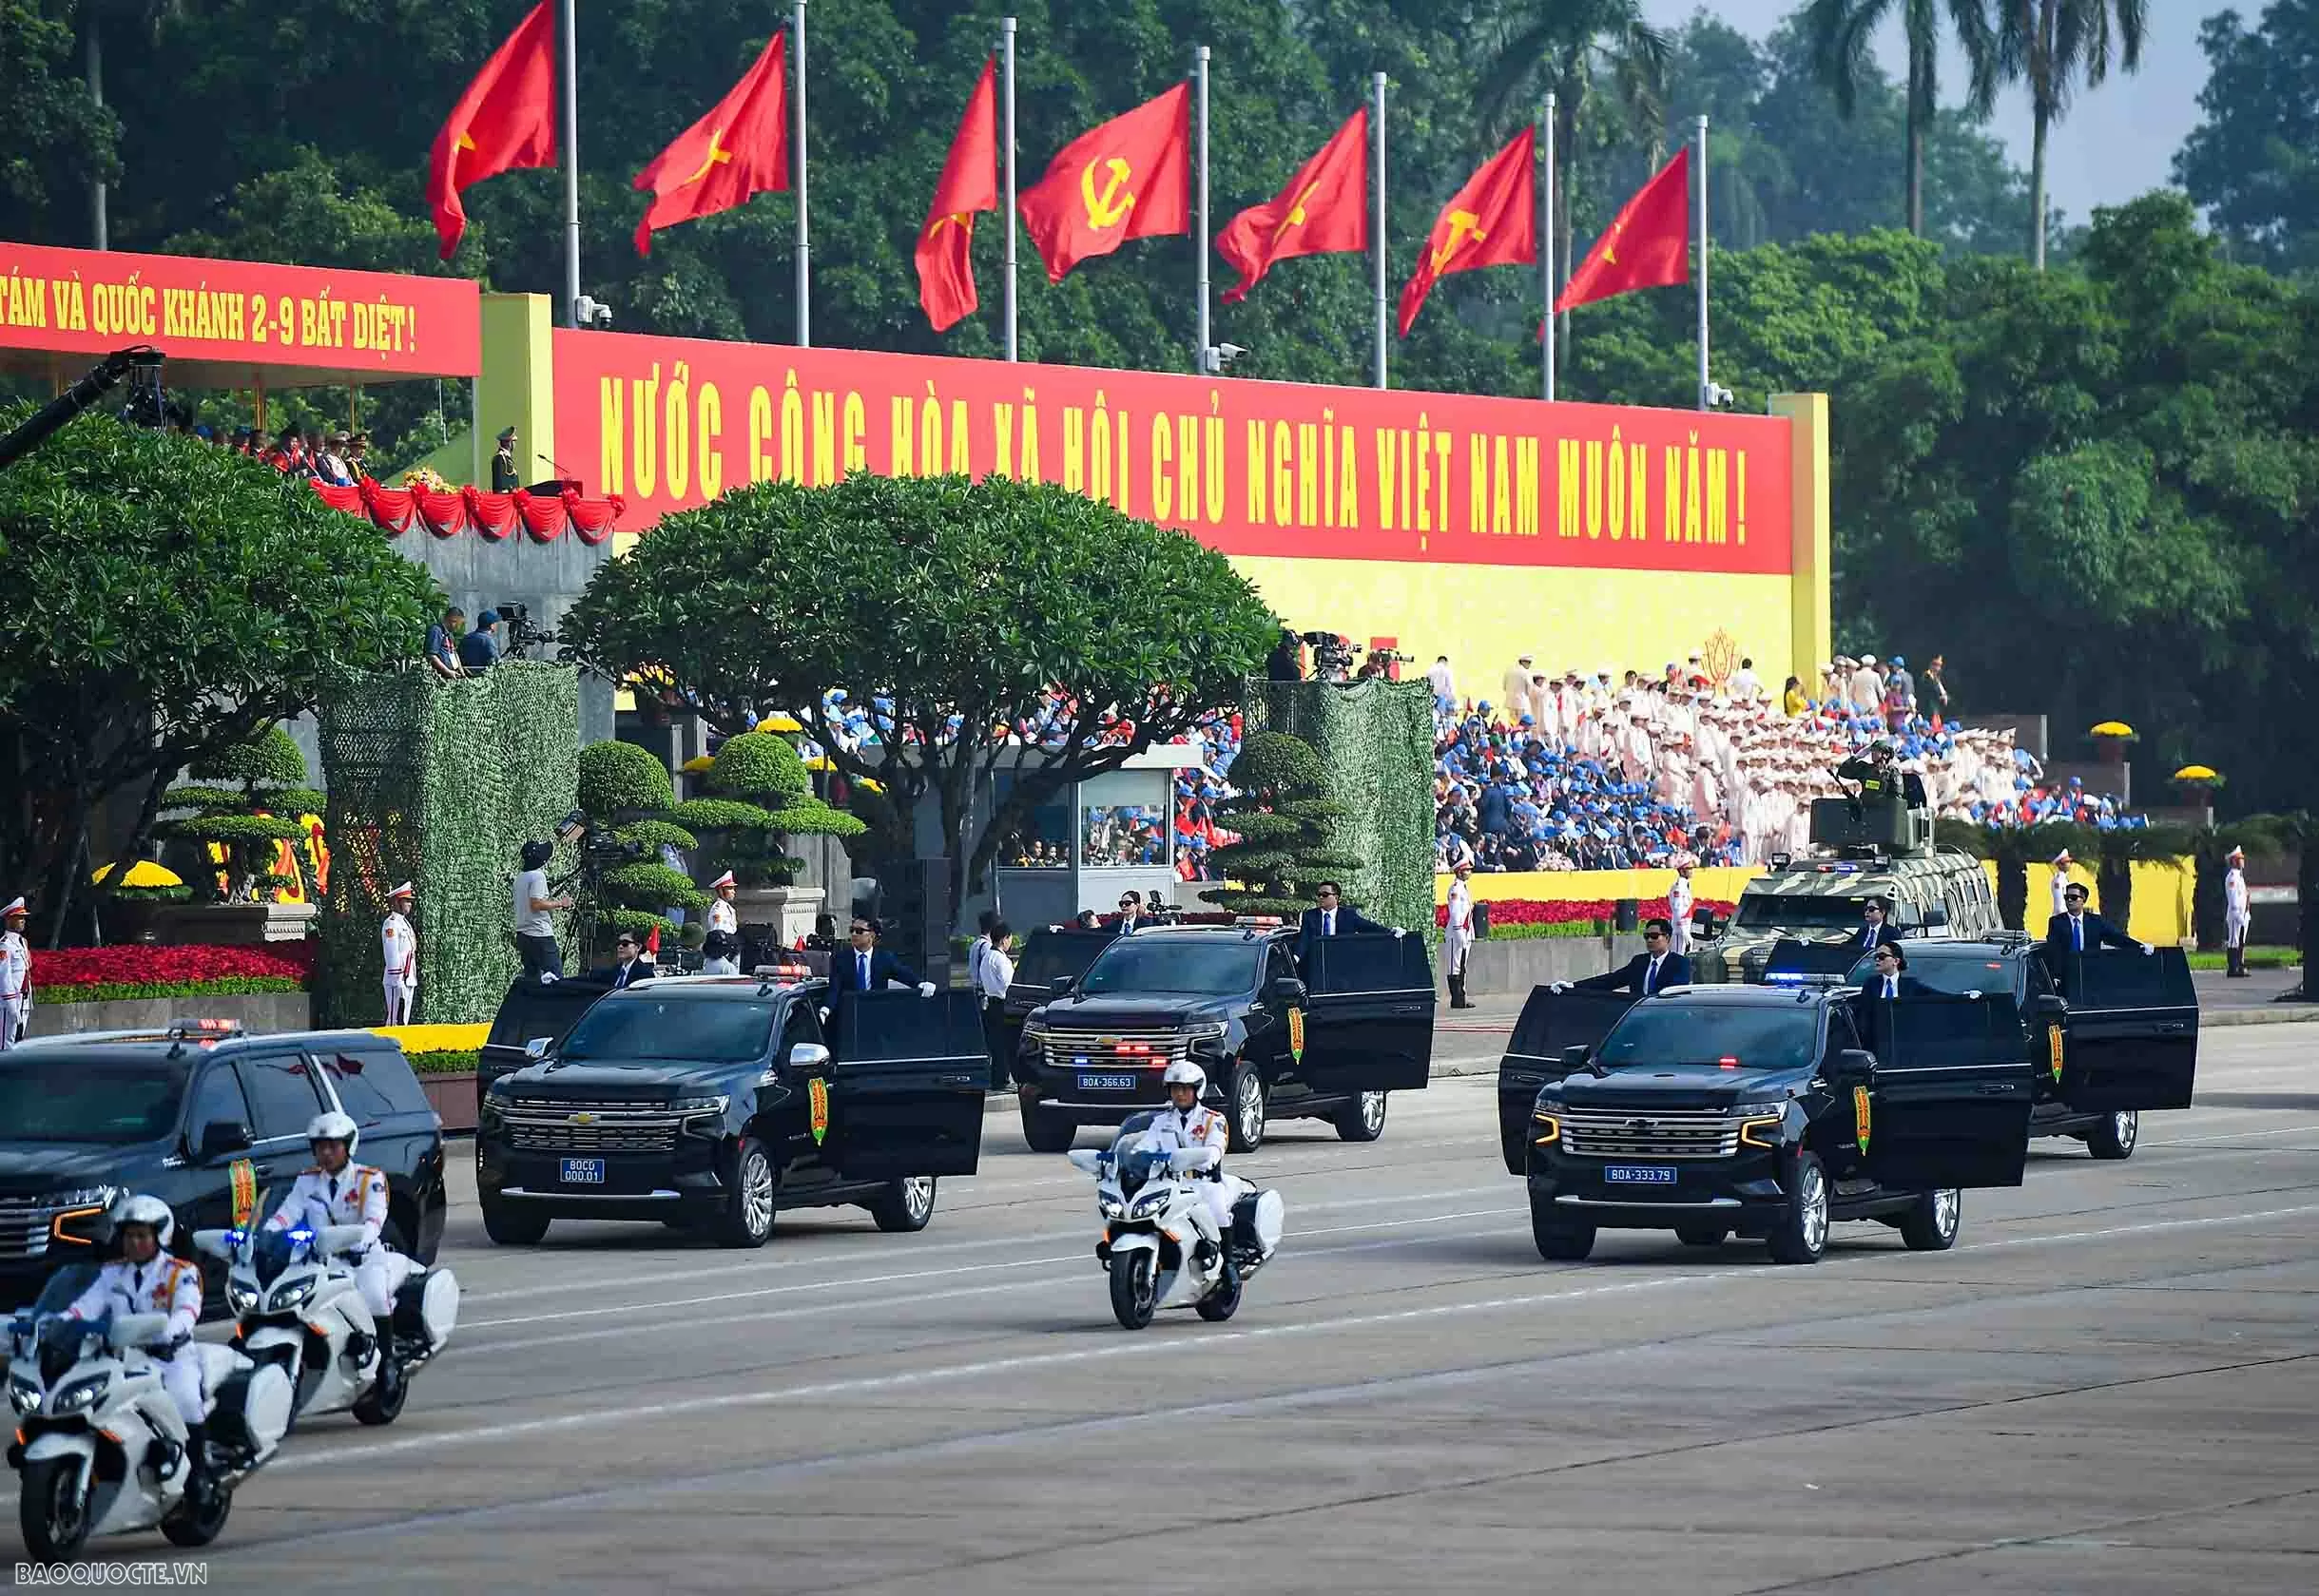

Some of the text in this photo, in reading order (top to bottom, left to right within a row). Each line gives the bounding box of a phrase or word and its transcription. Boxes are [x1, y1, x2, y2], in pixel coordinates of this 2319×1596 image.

[52, 270, 87, 330] VÀ
[92, 270, 156, 337] QUỐC
[163, 281, 245, 340] KHÁNH
[251, 294, 294, 345] 2-9
[301, 285, 346, 347] BẤT
[601, 360, 723, 501] NƯỚC
[994, 387, 1040, 486] XÃ
[1151, 390, 1225, 523] CHỦ
[1247, 407, 1359, 529] NGHĨA
[1377, 412, 1452, 551] VIỆT
[1470, 433, 1539, 535] NAM
[1558, 425, 1647, 541] MUÔN
[1612, 1169, 1671, 1181] 80A-333.79
